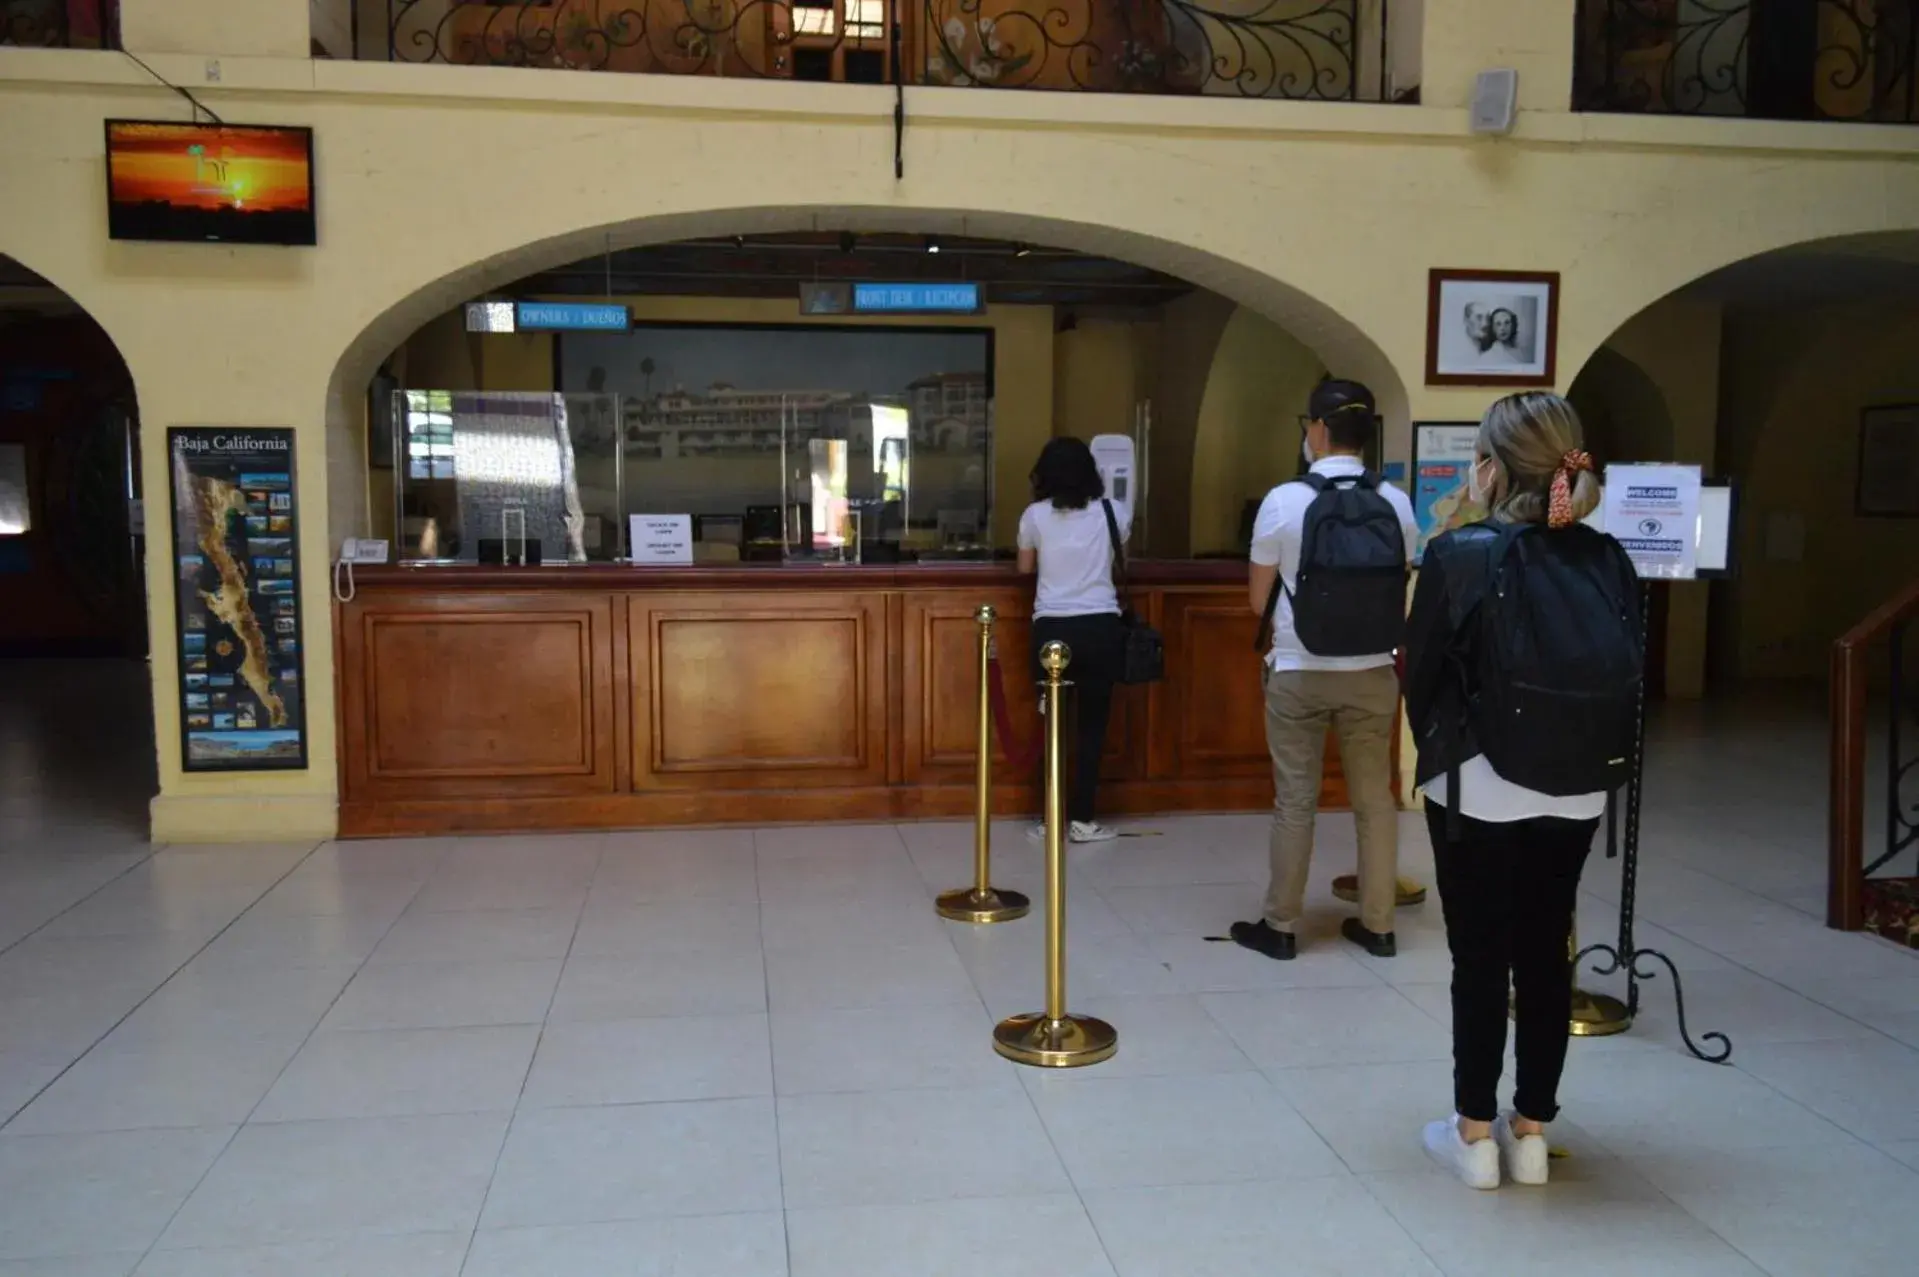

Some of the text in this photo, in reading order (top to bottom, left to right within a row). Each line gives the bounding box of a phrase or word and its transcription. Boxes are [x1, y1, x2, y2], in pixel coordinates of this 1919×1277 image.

[522, 309, 570, 323] OWNERS
[178, 435, 287, 452] Baja California
[1627, 488, 1677, 498] WELCOME
